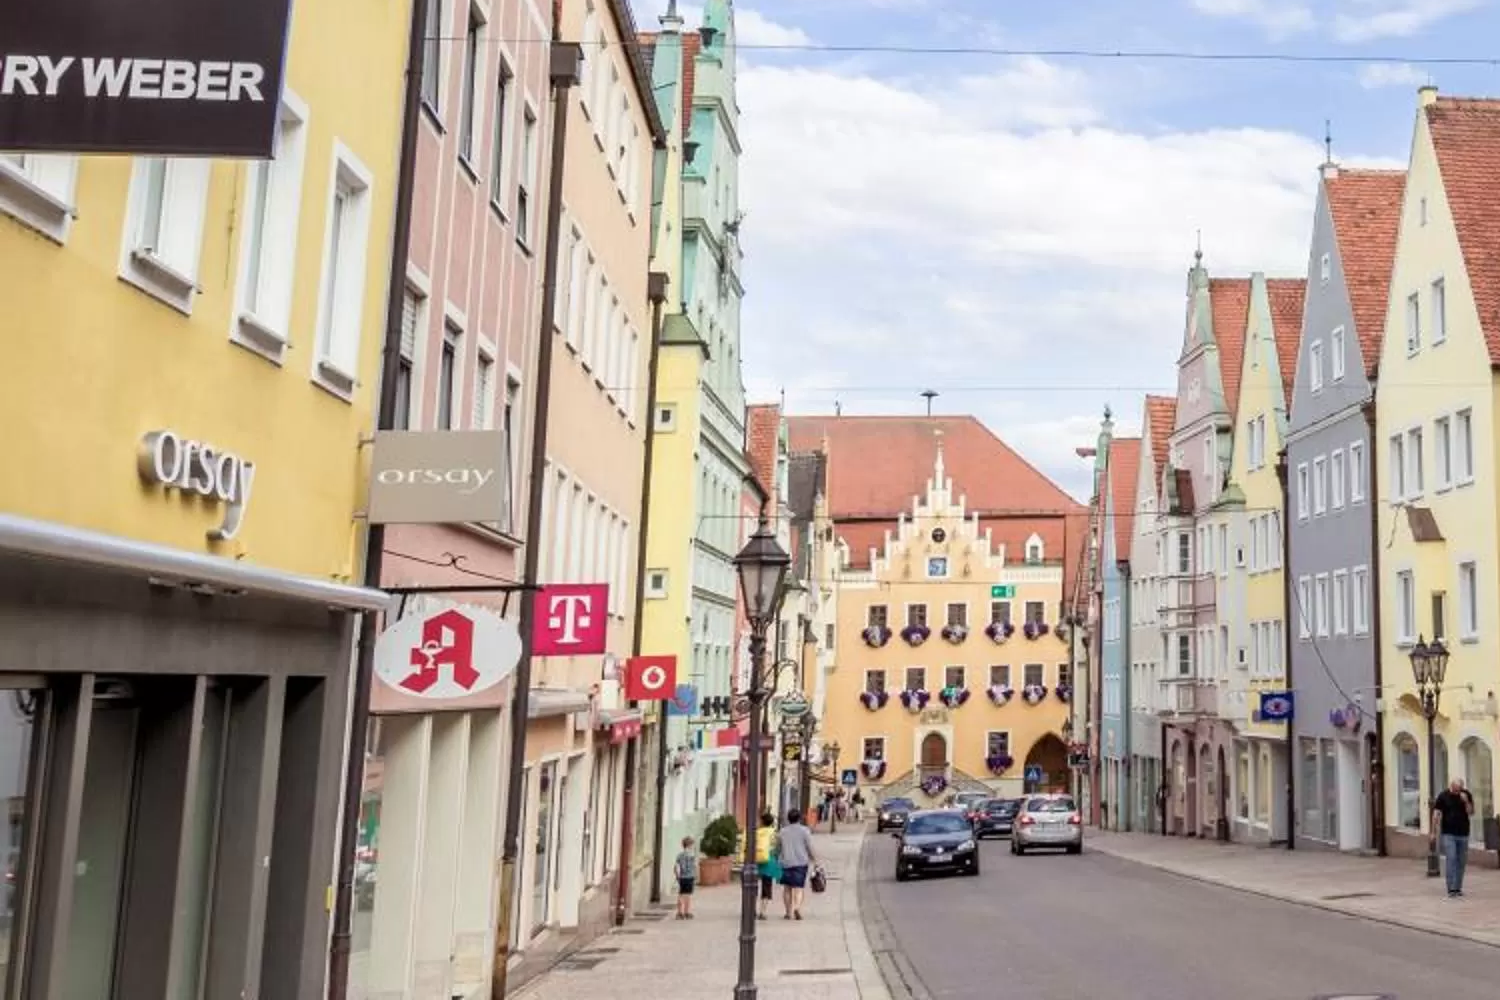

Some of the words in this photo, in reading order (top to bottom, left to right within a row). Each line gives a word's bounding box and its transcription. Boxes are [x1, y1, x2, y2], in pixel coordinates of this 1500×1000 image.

[0, 55, 75, 95] RY
[82, 57, 264, 101] WEBER
[151, 431, 256, 540] orsay
[378, 468, 495, 495] orsay
